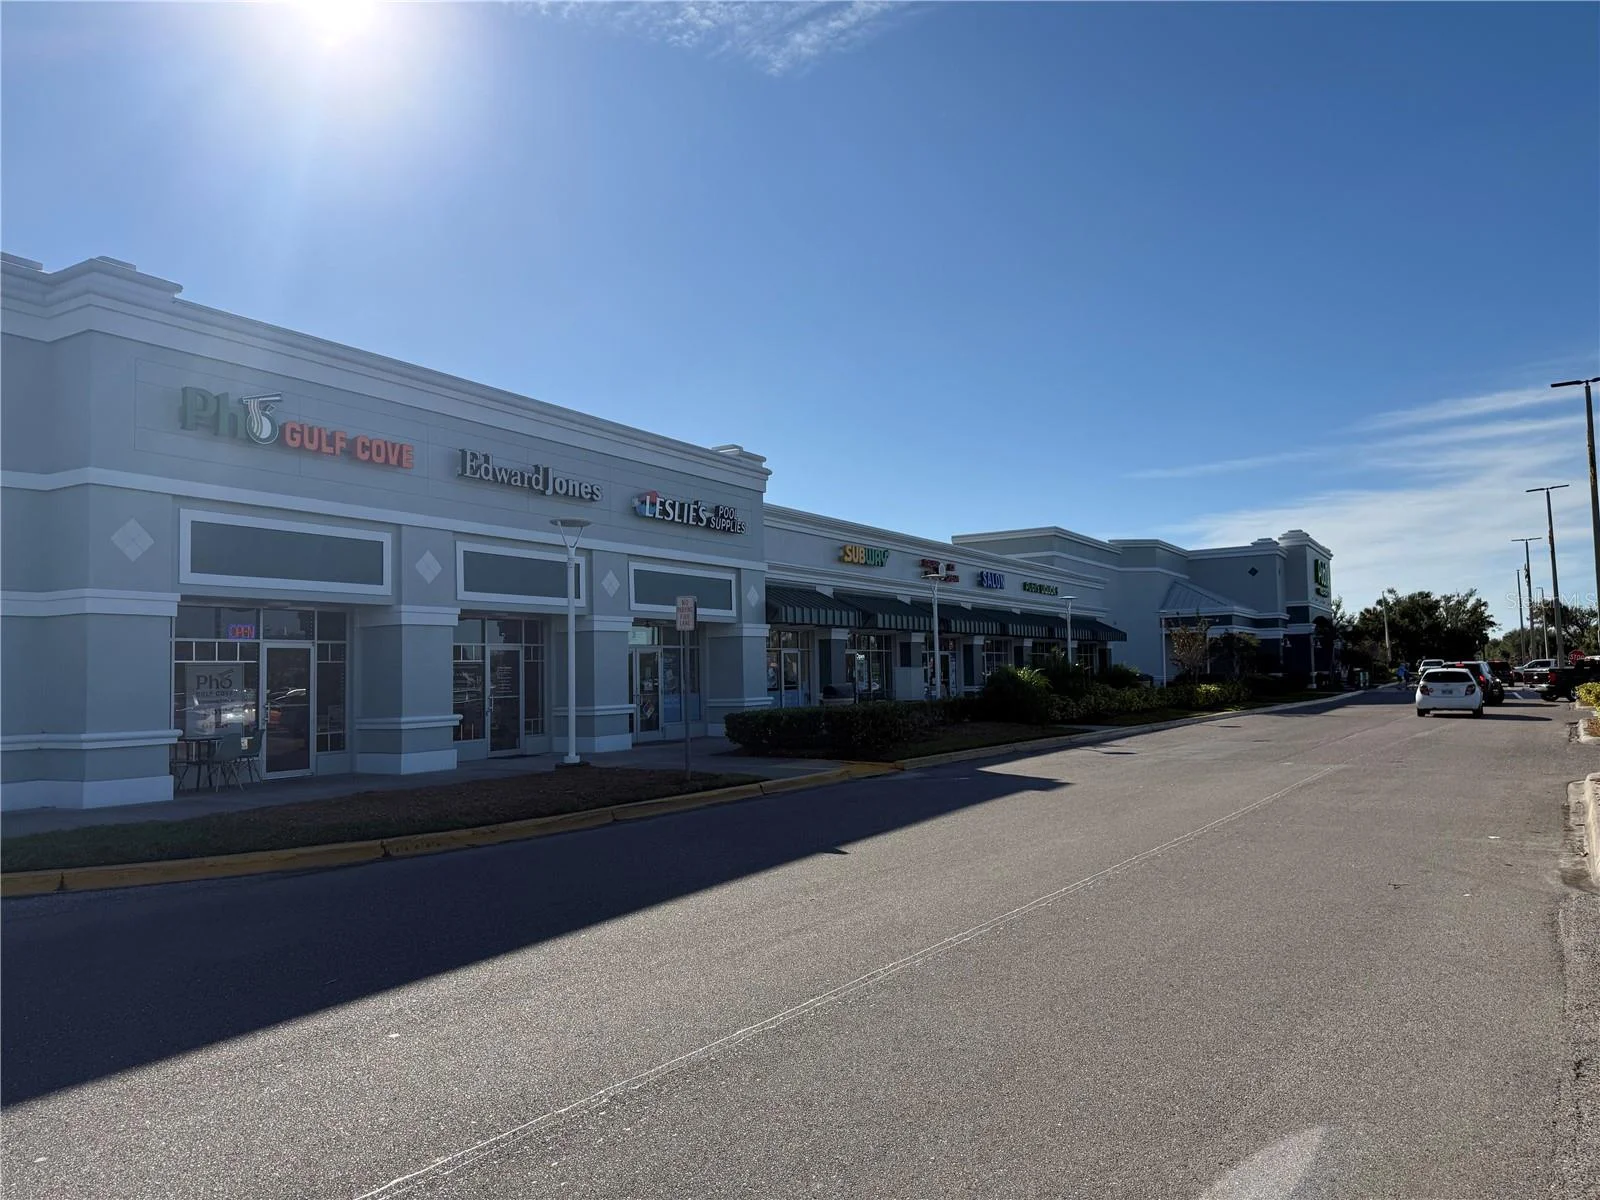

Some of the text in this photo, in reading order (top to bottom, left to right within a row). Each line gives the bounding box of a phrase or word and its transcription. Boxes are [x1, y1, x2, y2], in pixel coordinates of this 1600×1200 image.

[283, 420, 348, 456] GULF
[354, 435, 415, 469] COVE
[459, 449, 602, 501] Edward Jones
[644, 495, 708, 527] LESLIE'S
[718, 505, 738, 520] POOL
[709, 516, 746, 534] SUPPLIES
[843, 544, 890, 568] SUBWAY
[982, 570, 1006, 590] SALON
